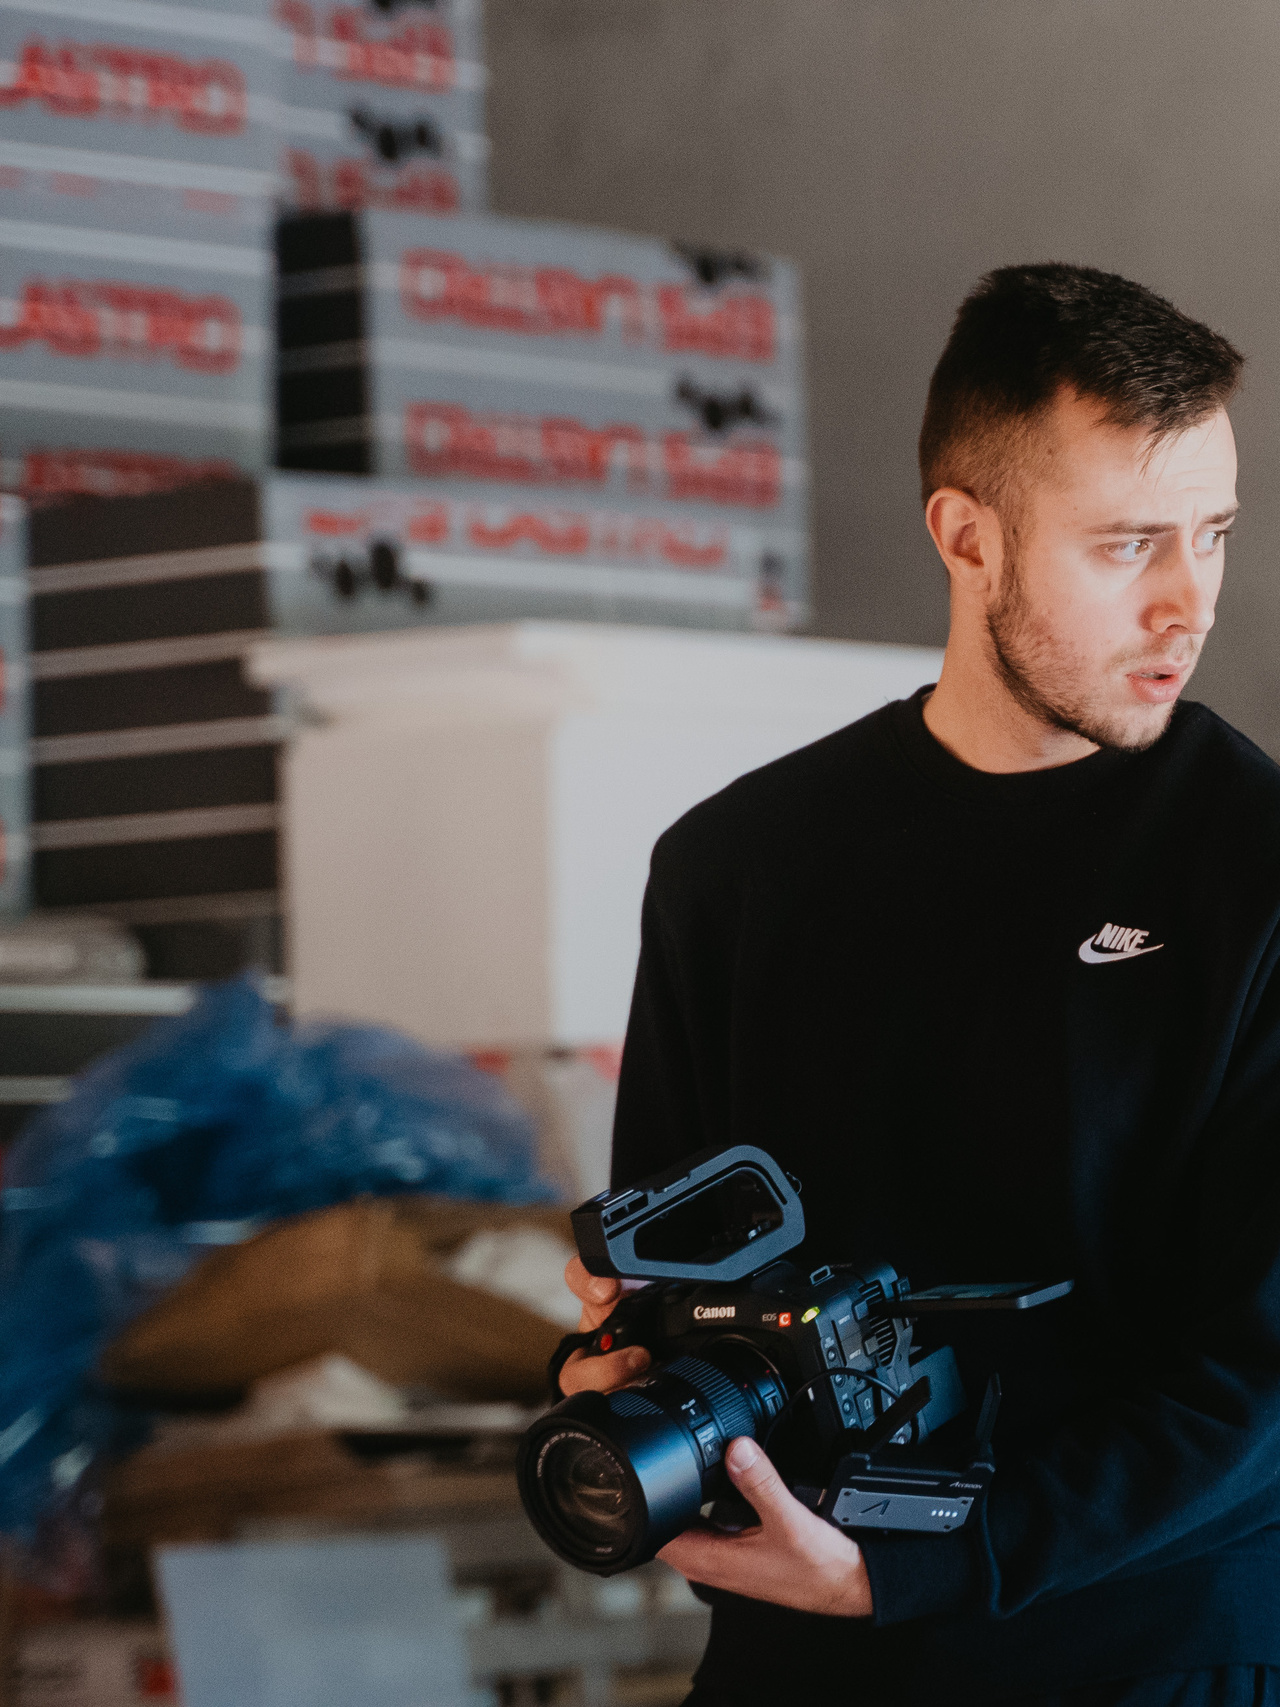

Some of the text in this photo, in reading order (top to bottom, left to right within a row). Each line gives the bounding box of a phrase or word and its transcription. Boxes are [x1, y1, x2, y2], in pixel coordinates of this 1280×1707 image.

[1094, 922, 1150, 952] NIKE
[693, 1305, 736, 1320] Canon
[762, 1312, 790, 1326] EOS C
